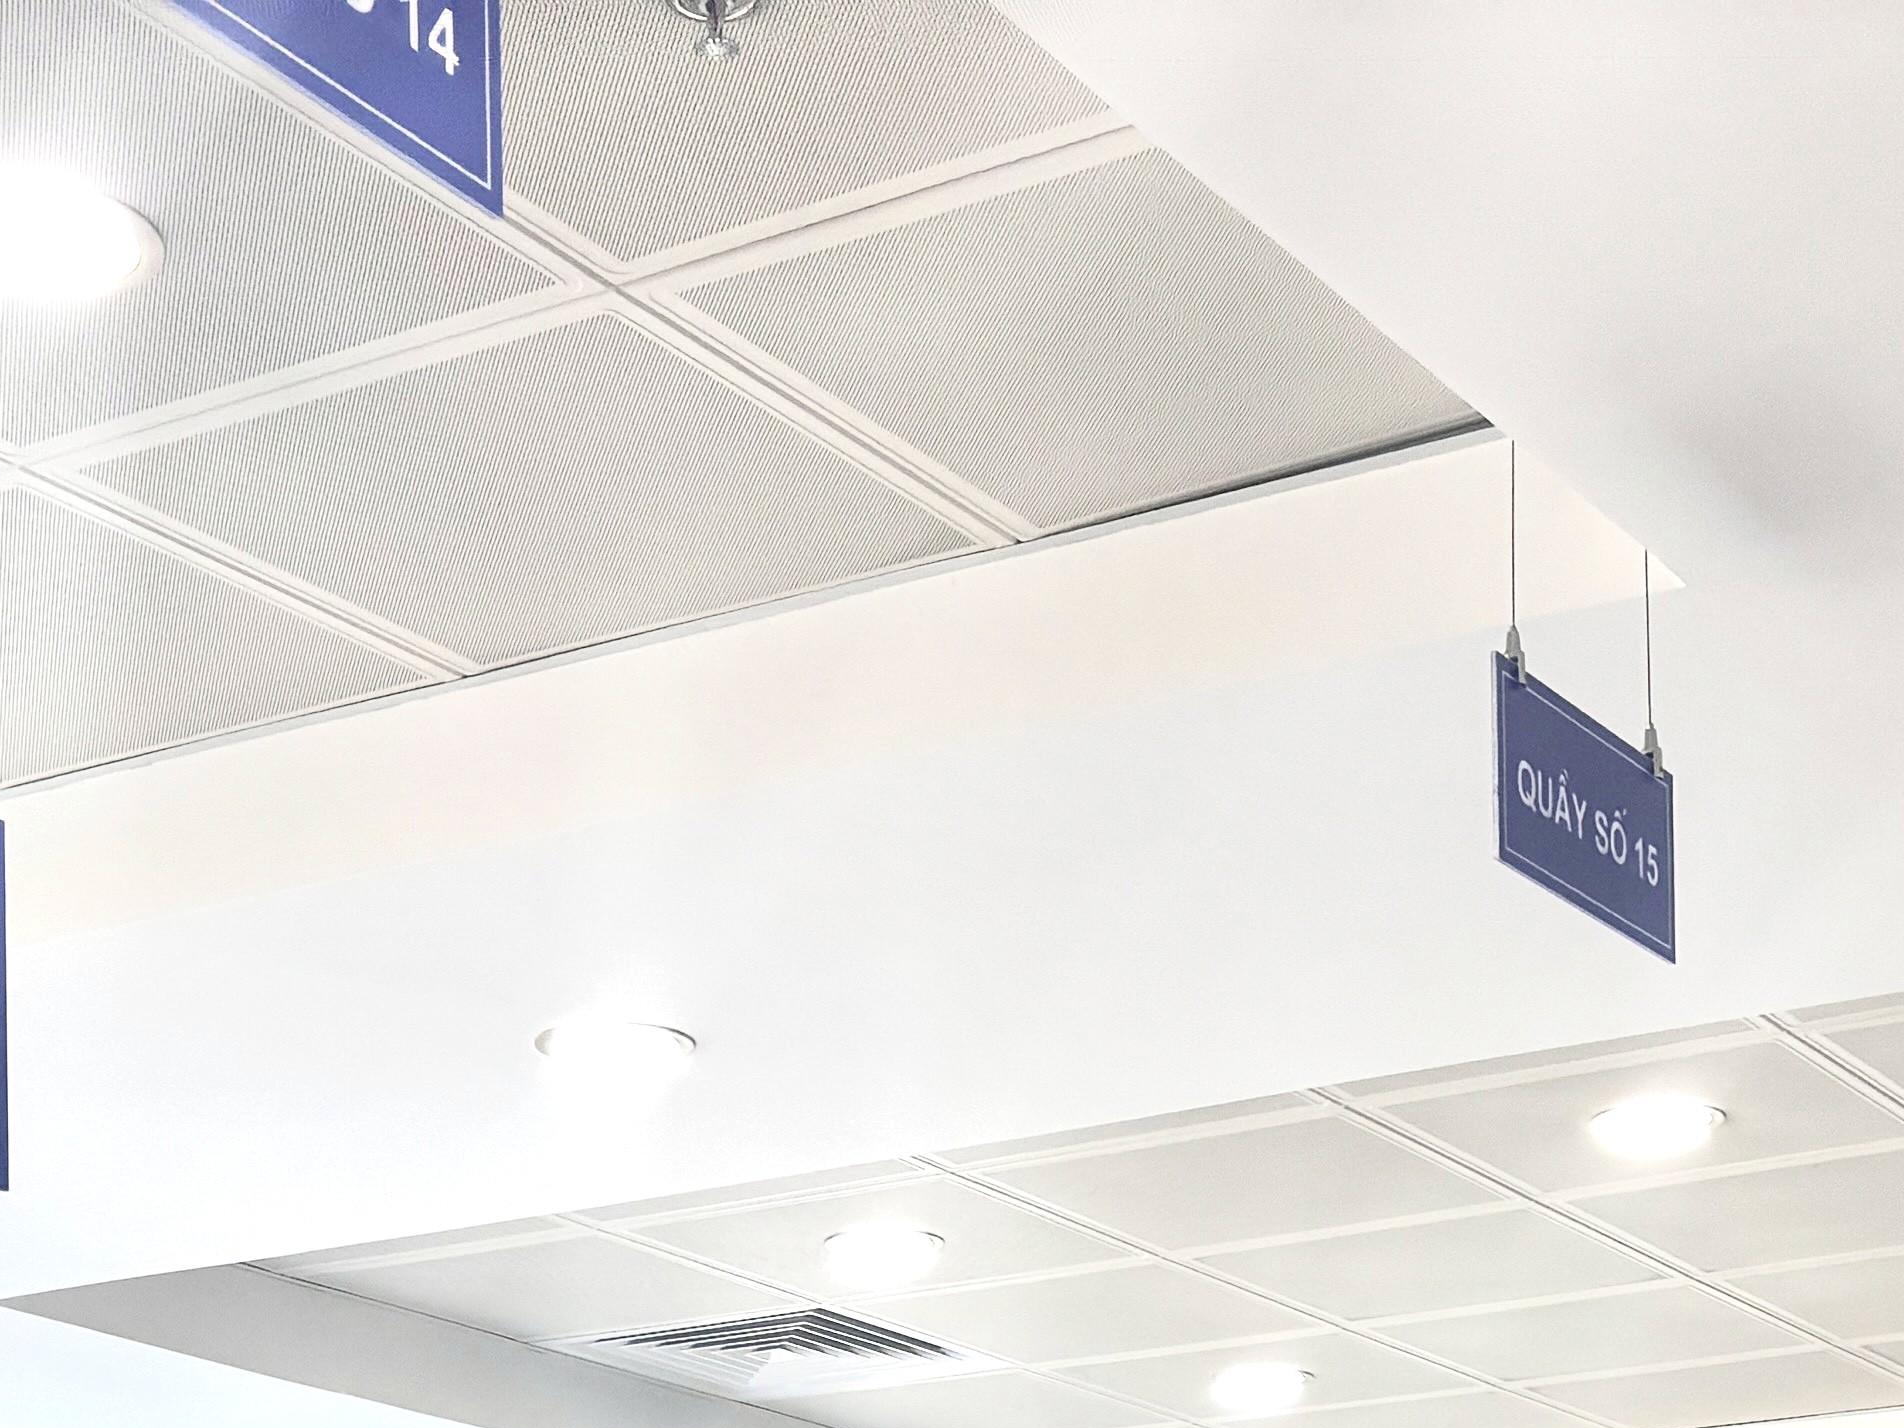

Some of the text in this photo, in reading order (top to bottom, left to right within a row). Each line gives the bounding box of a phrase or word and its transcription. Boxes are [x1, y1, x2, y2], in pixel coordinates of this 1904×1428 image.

[1517, 760, 1659, 887] QUẦY SỐ 15
